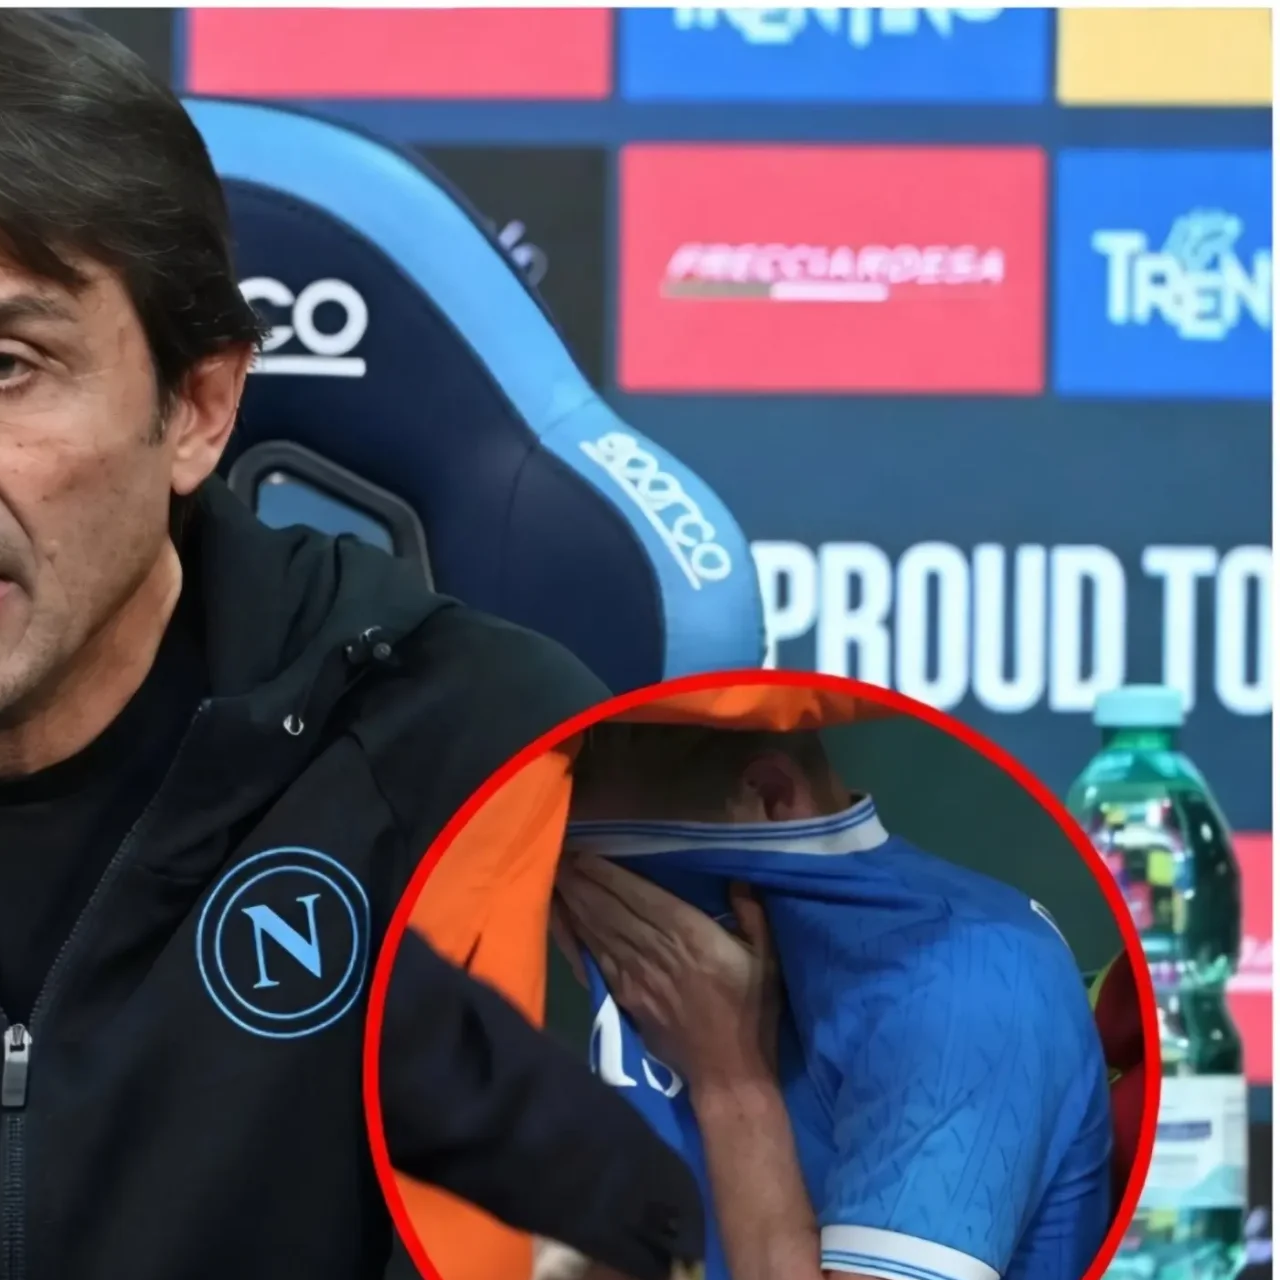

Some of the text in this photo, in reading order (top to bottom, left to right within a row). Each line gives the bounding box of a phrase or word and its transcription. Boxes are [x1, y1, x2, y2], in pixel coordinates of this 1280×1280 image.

[751, 540, 1273, 716] PROUD TO
[241, 893, 322, 989] N
